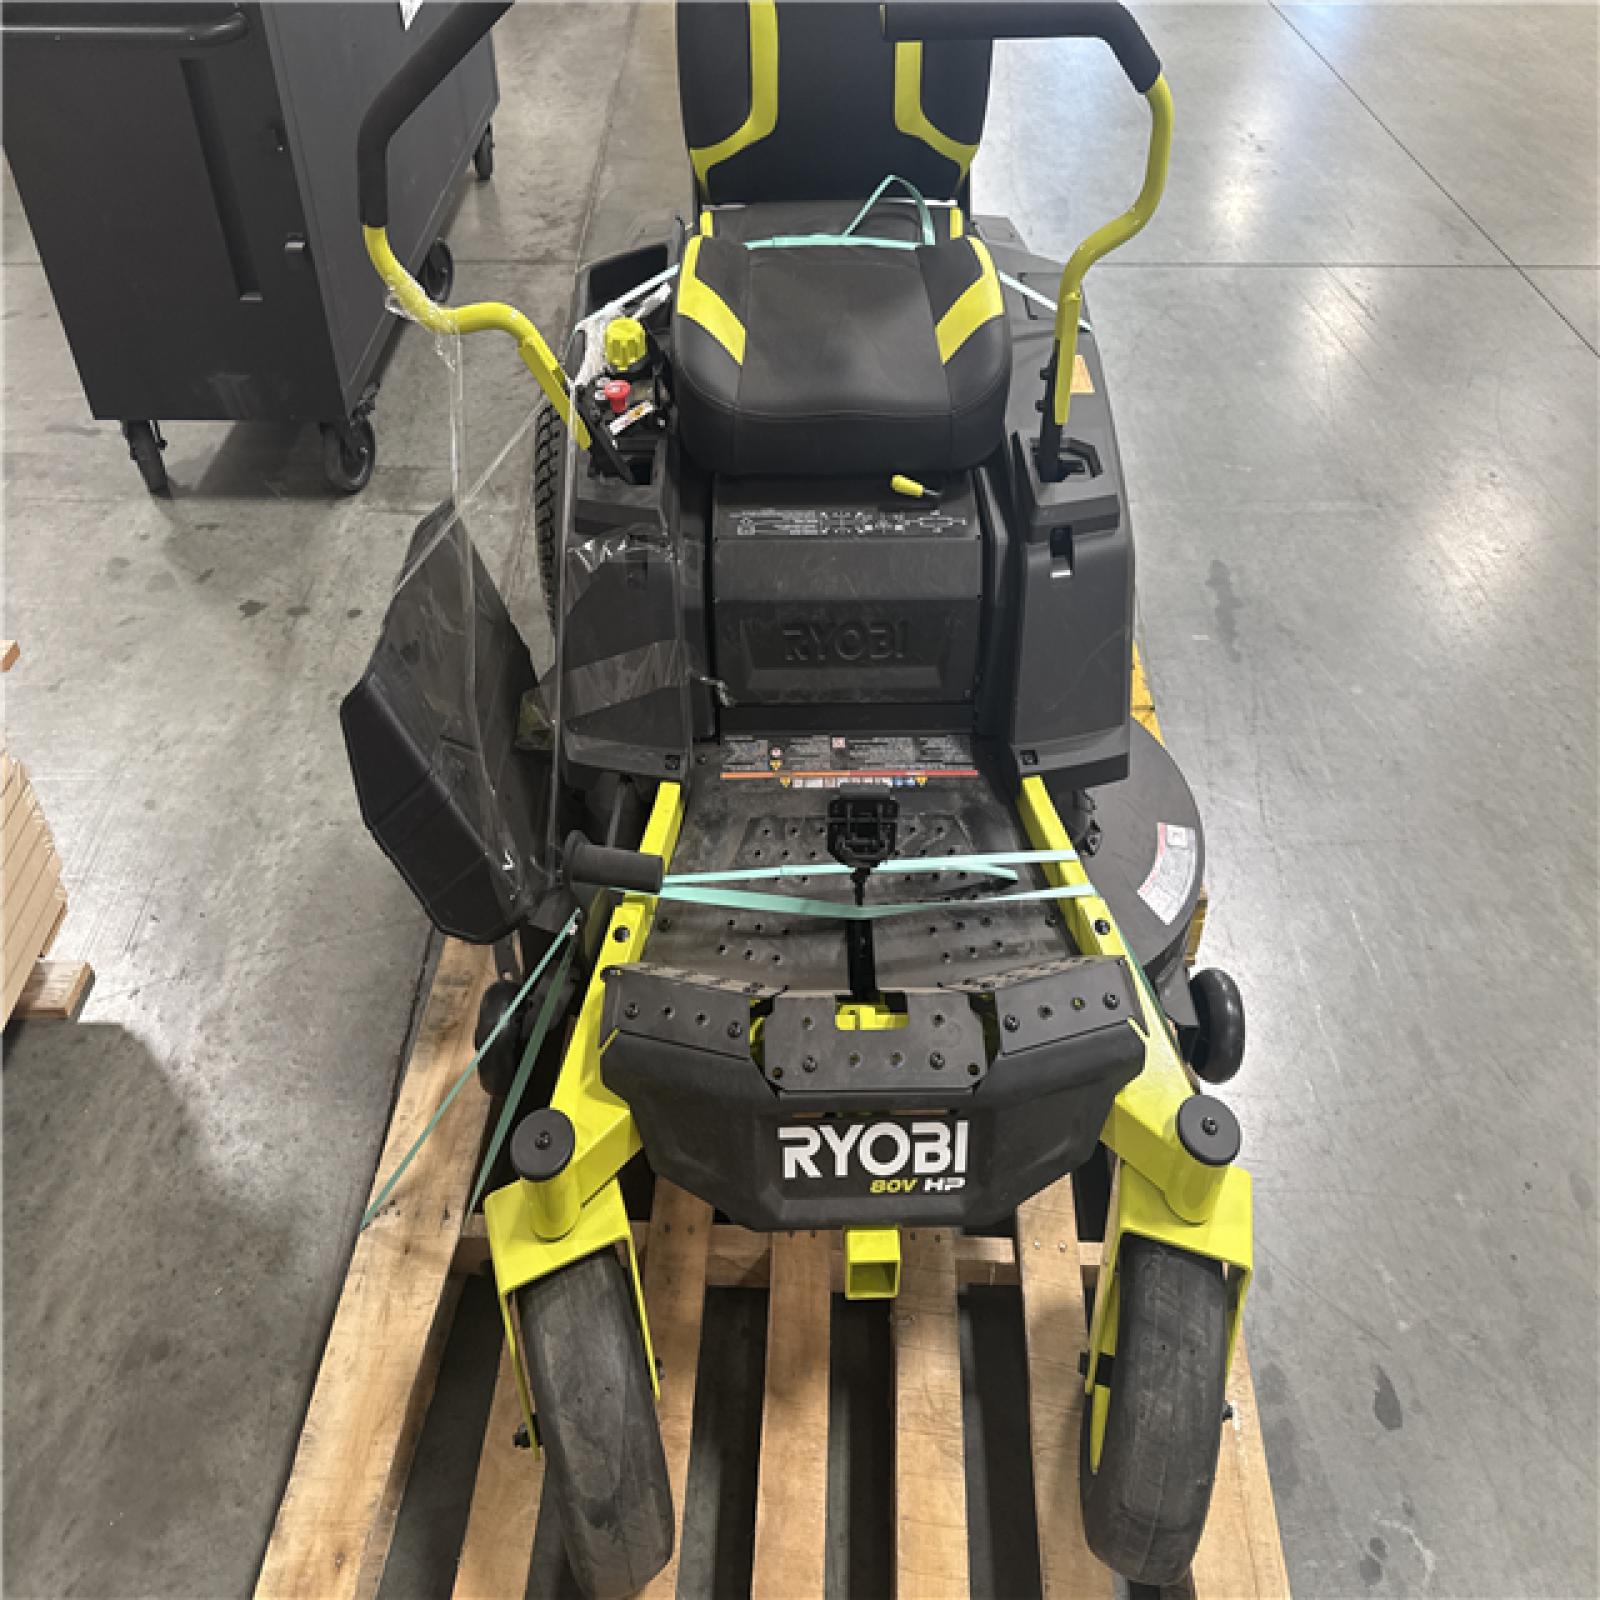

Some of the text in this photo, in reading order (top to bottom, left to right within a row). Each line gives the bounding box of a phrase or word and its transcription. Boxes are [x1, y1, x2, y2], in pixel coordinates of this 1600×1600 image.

[782, 624, 908, 661] RYOBI
[777, 1120, 969, 1179] RYOBI
[869, 1177, 966, 1194] 80V HP
